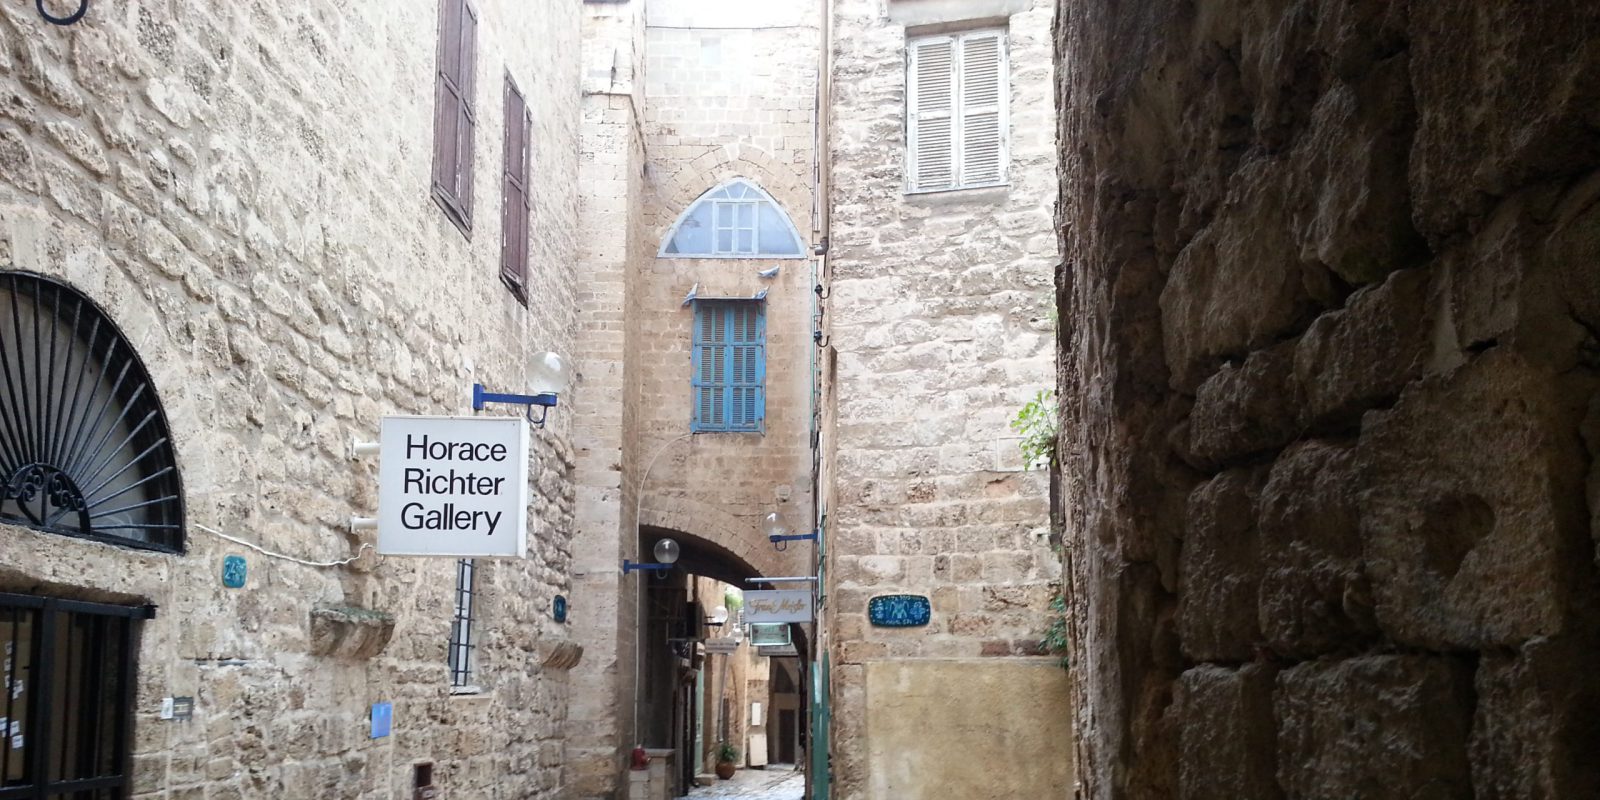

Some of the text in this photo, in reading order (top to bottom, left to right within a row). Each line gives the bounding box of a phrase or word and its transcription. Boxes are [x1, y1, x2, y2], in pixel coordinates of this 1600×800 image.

[406, 434, 507, 462] Horace
[403, 467, 506, 495] Richter
[400, 502, 502, 536] Gallery
